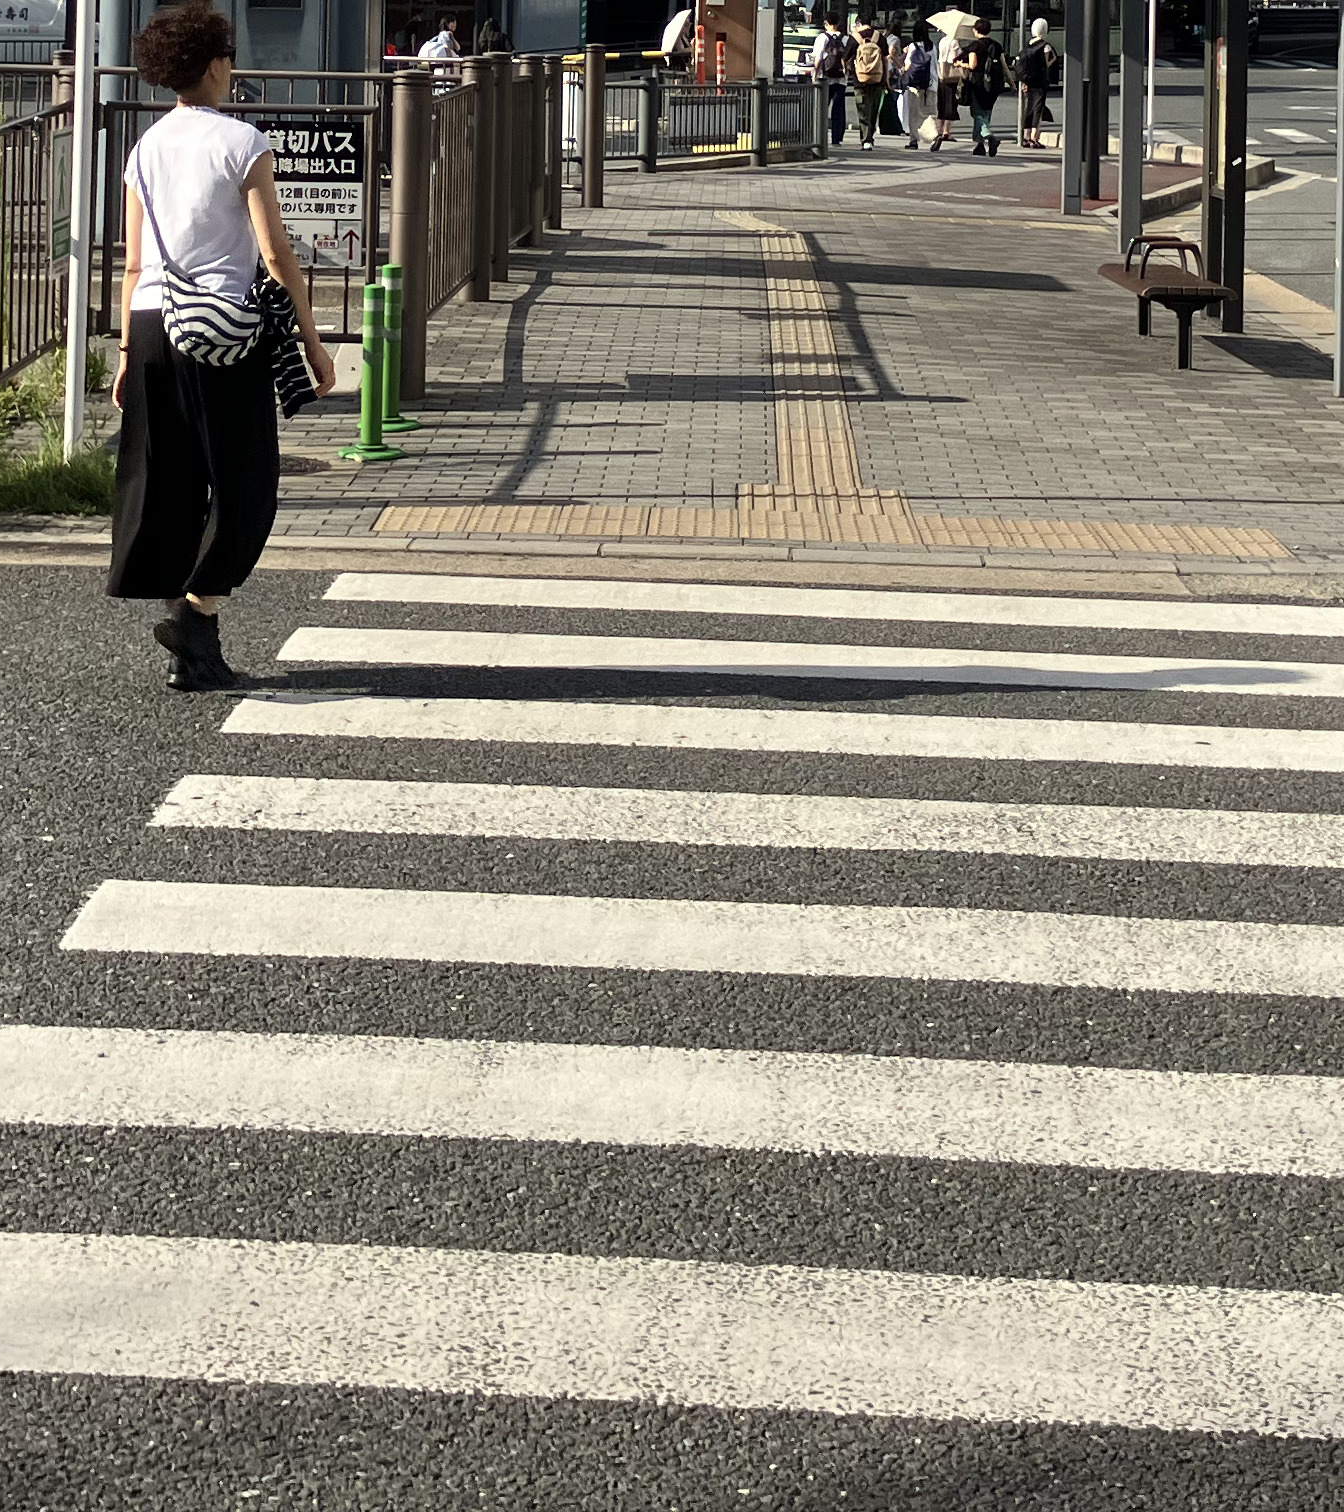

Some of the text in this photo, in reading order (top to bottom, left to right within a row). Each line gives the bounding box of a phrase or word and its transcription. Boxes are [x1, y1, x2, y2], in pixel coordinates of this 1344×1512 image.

[264, 129, 356, 154] 貸切バス
[279, 202, 357, 214] のバス専用です
